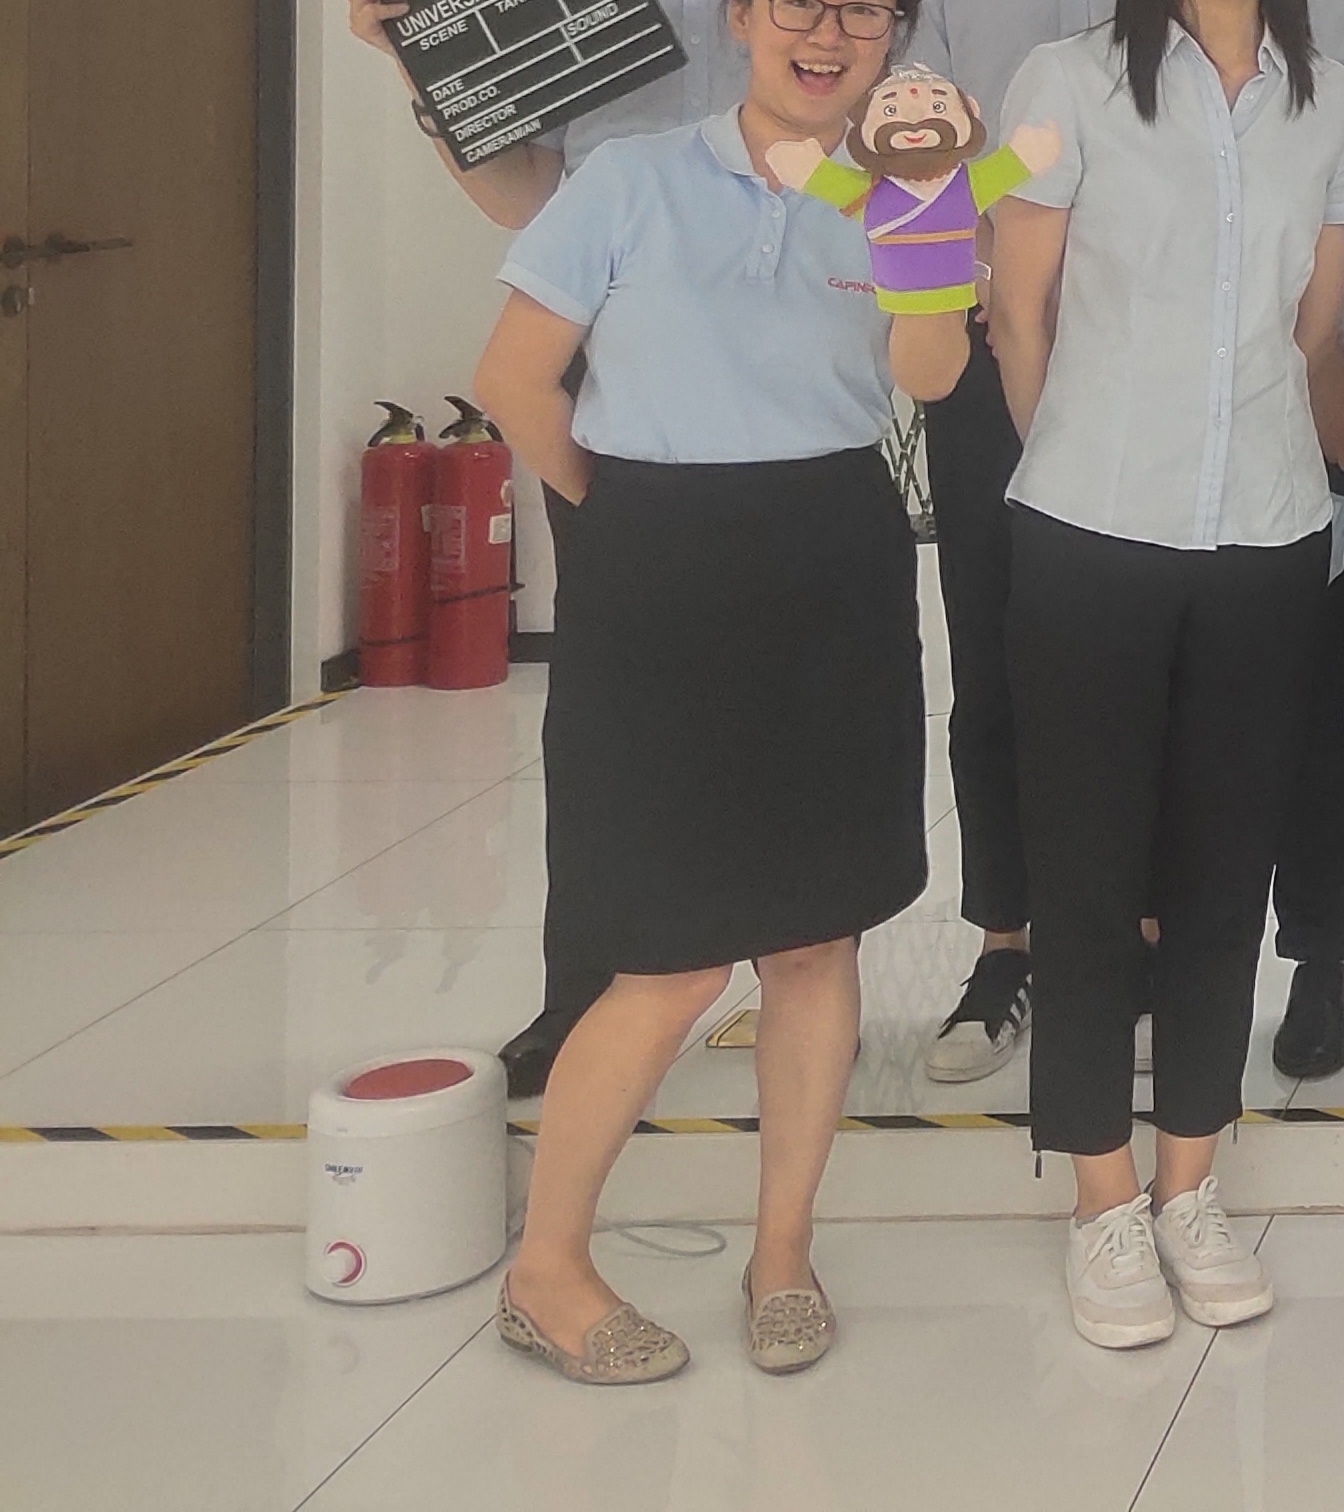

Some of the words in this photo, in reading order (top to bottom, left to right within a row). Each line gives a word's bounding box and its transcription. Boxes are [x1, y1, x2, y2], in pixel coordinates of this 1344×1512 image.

[419, 19, 469, 51] SCENE
[432, 79, 465, 101] DATE
[567, 2, 619, 36] SOUND
[442, 85, 501, 120] PROD.CO.
[455, 104, 518, 142] DIRECTOR
[466, 119, 542, 163] CAMERAMAN
